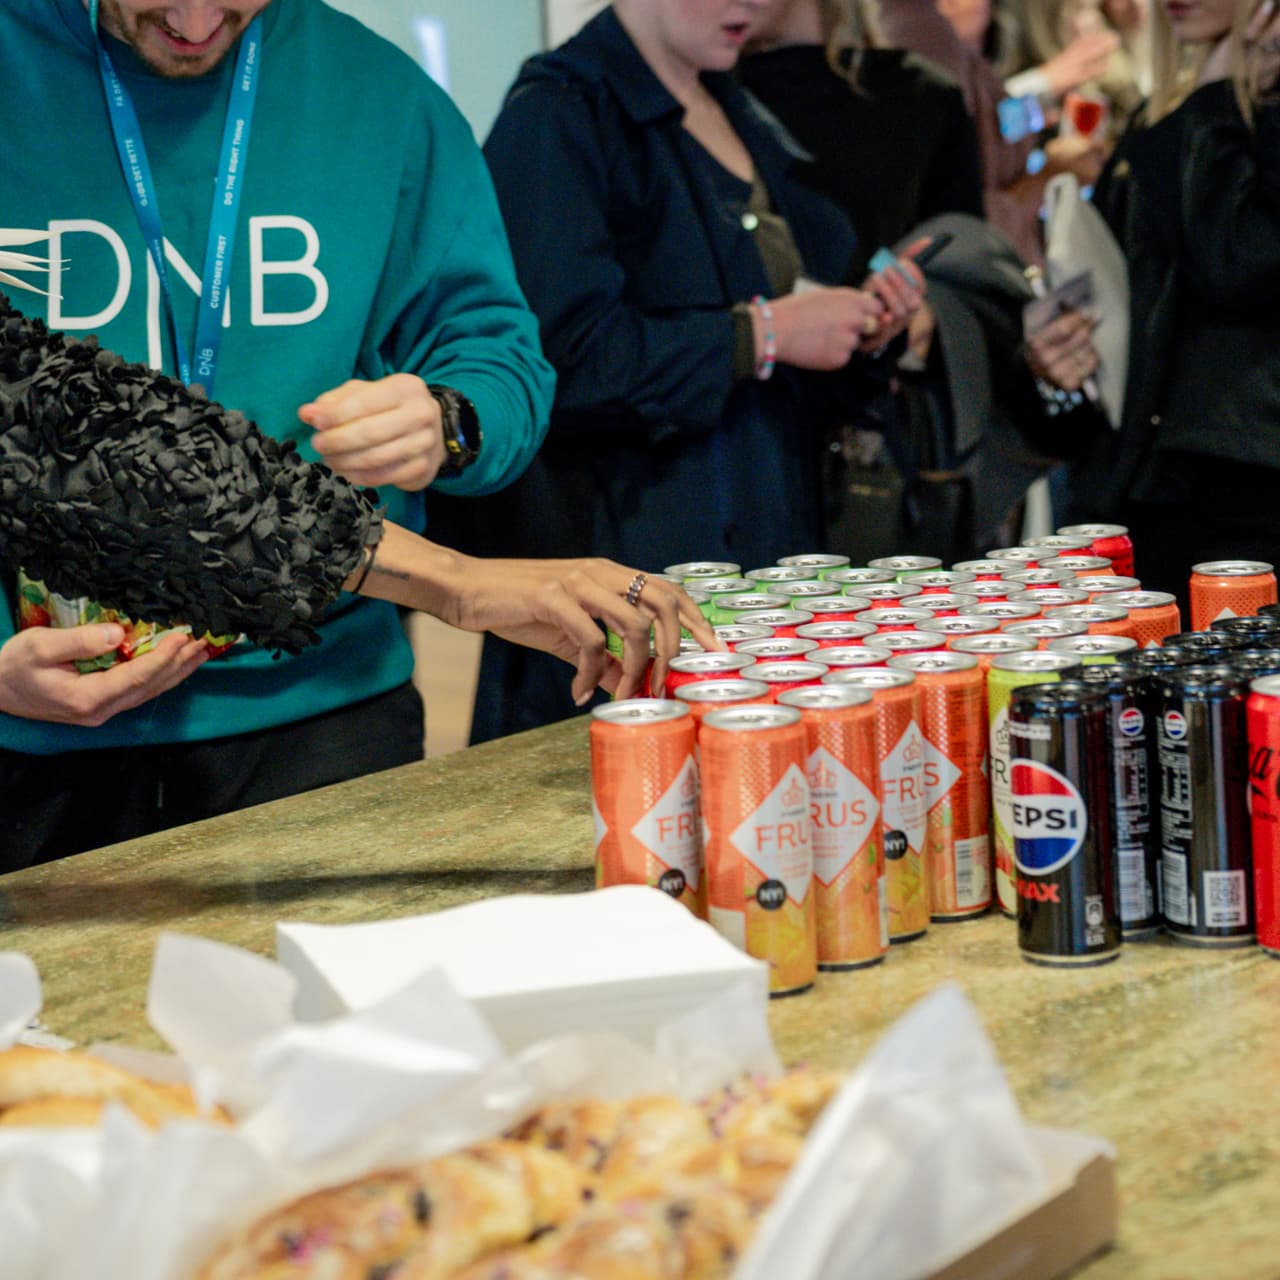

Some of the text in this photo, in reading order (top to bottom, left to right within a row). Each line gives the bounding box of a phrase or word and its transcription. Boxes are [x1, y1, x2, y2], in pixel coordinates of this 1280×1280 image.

[242, 75, 252, 91] GET
[223, 119, 245, 206] DO THE RIGHT THING
[210, 235, 228, 309] CUSTOMER FIRST
[48, 215, 329, 370] DNB
[199, 347, 214, 377] DNB
[884, 837, 906, 852] NY!
[661, 878, 683, 891] NY!
[760, 885, 783, 902] NY!
